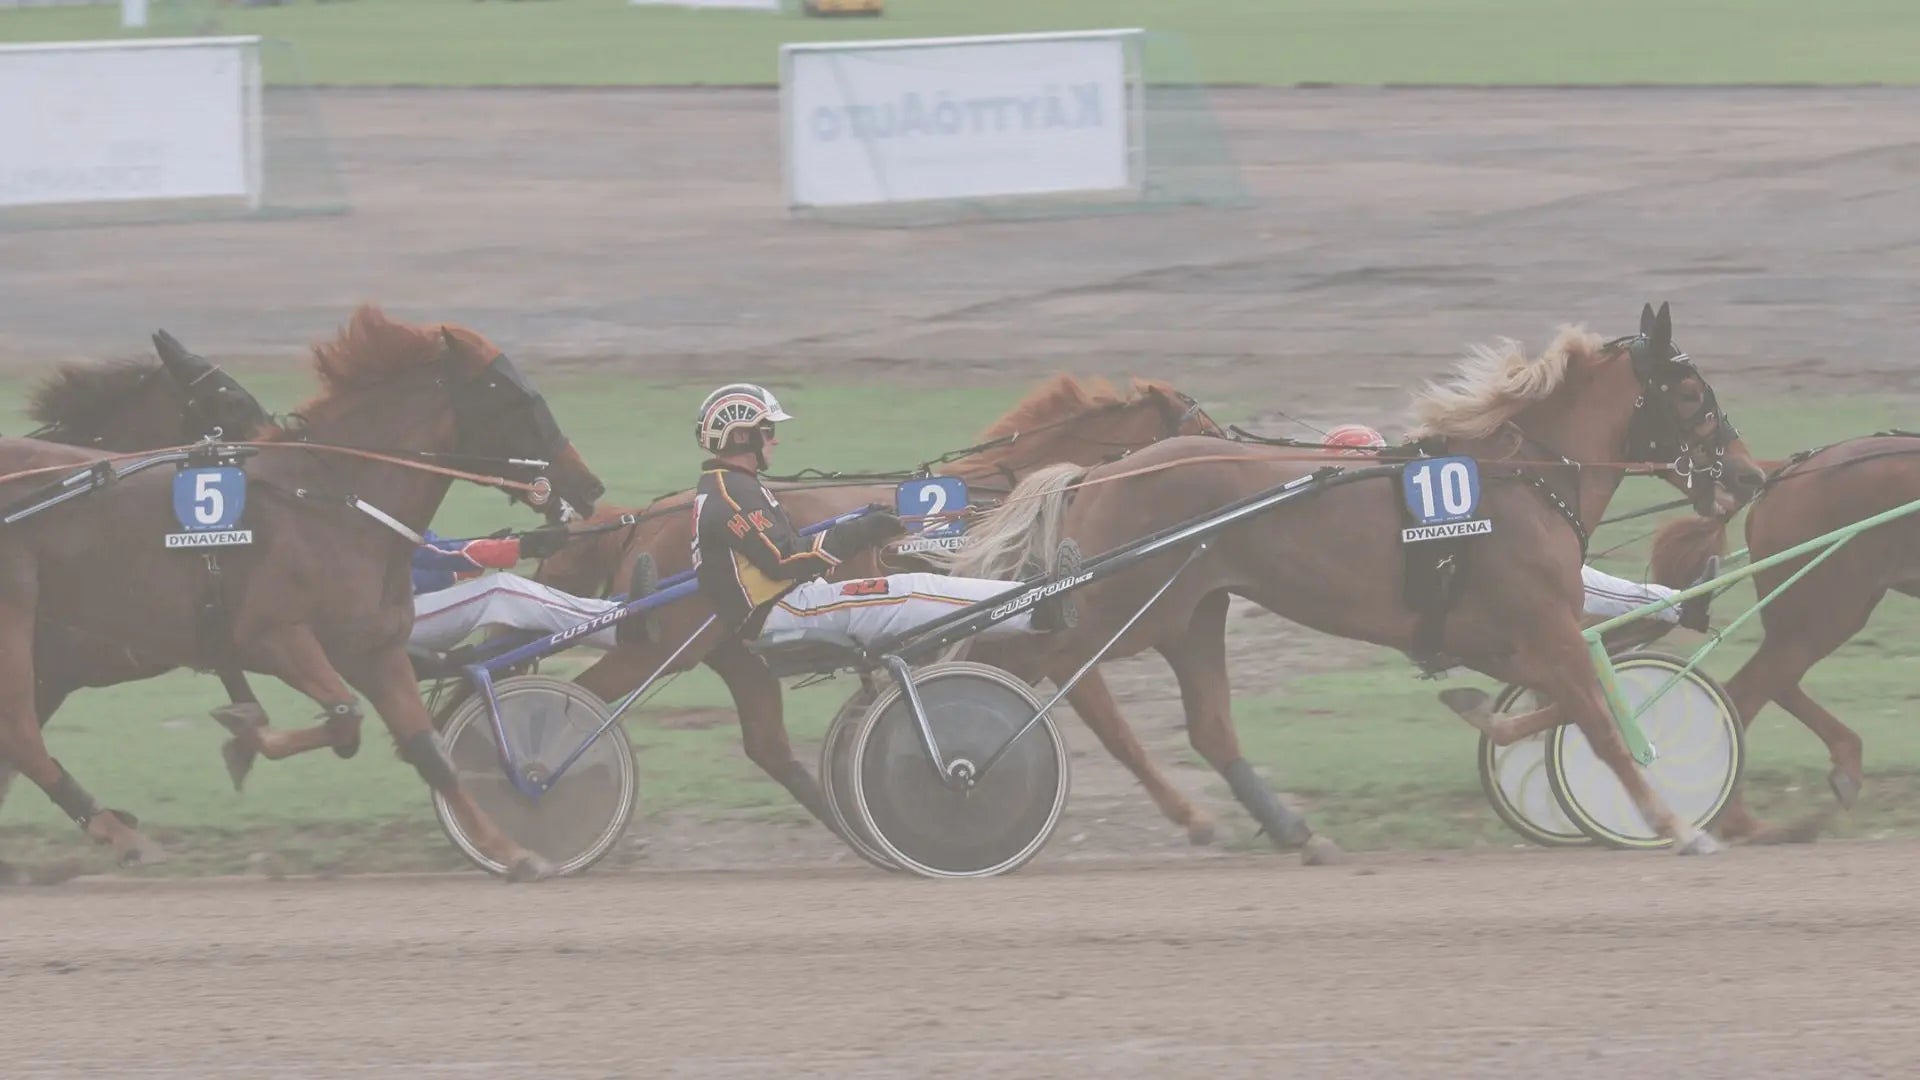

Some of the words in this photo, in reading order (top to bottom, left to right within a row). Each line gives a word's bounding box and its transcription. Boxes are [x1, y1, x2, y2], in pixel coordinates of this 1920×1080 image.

[194, 472, 224, 525] 5
[919, 484, 949, 531] 2
[1412, 462, 1472, 517] 10
[168, 531, 249, 546] DYNAVENA
[1405, 521, 1488, 541] DYNAVENA
[990, 576, 1075, 620] CUSTOM
[550, 607, 629, 645] CUSTOM
